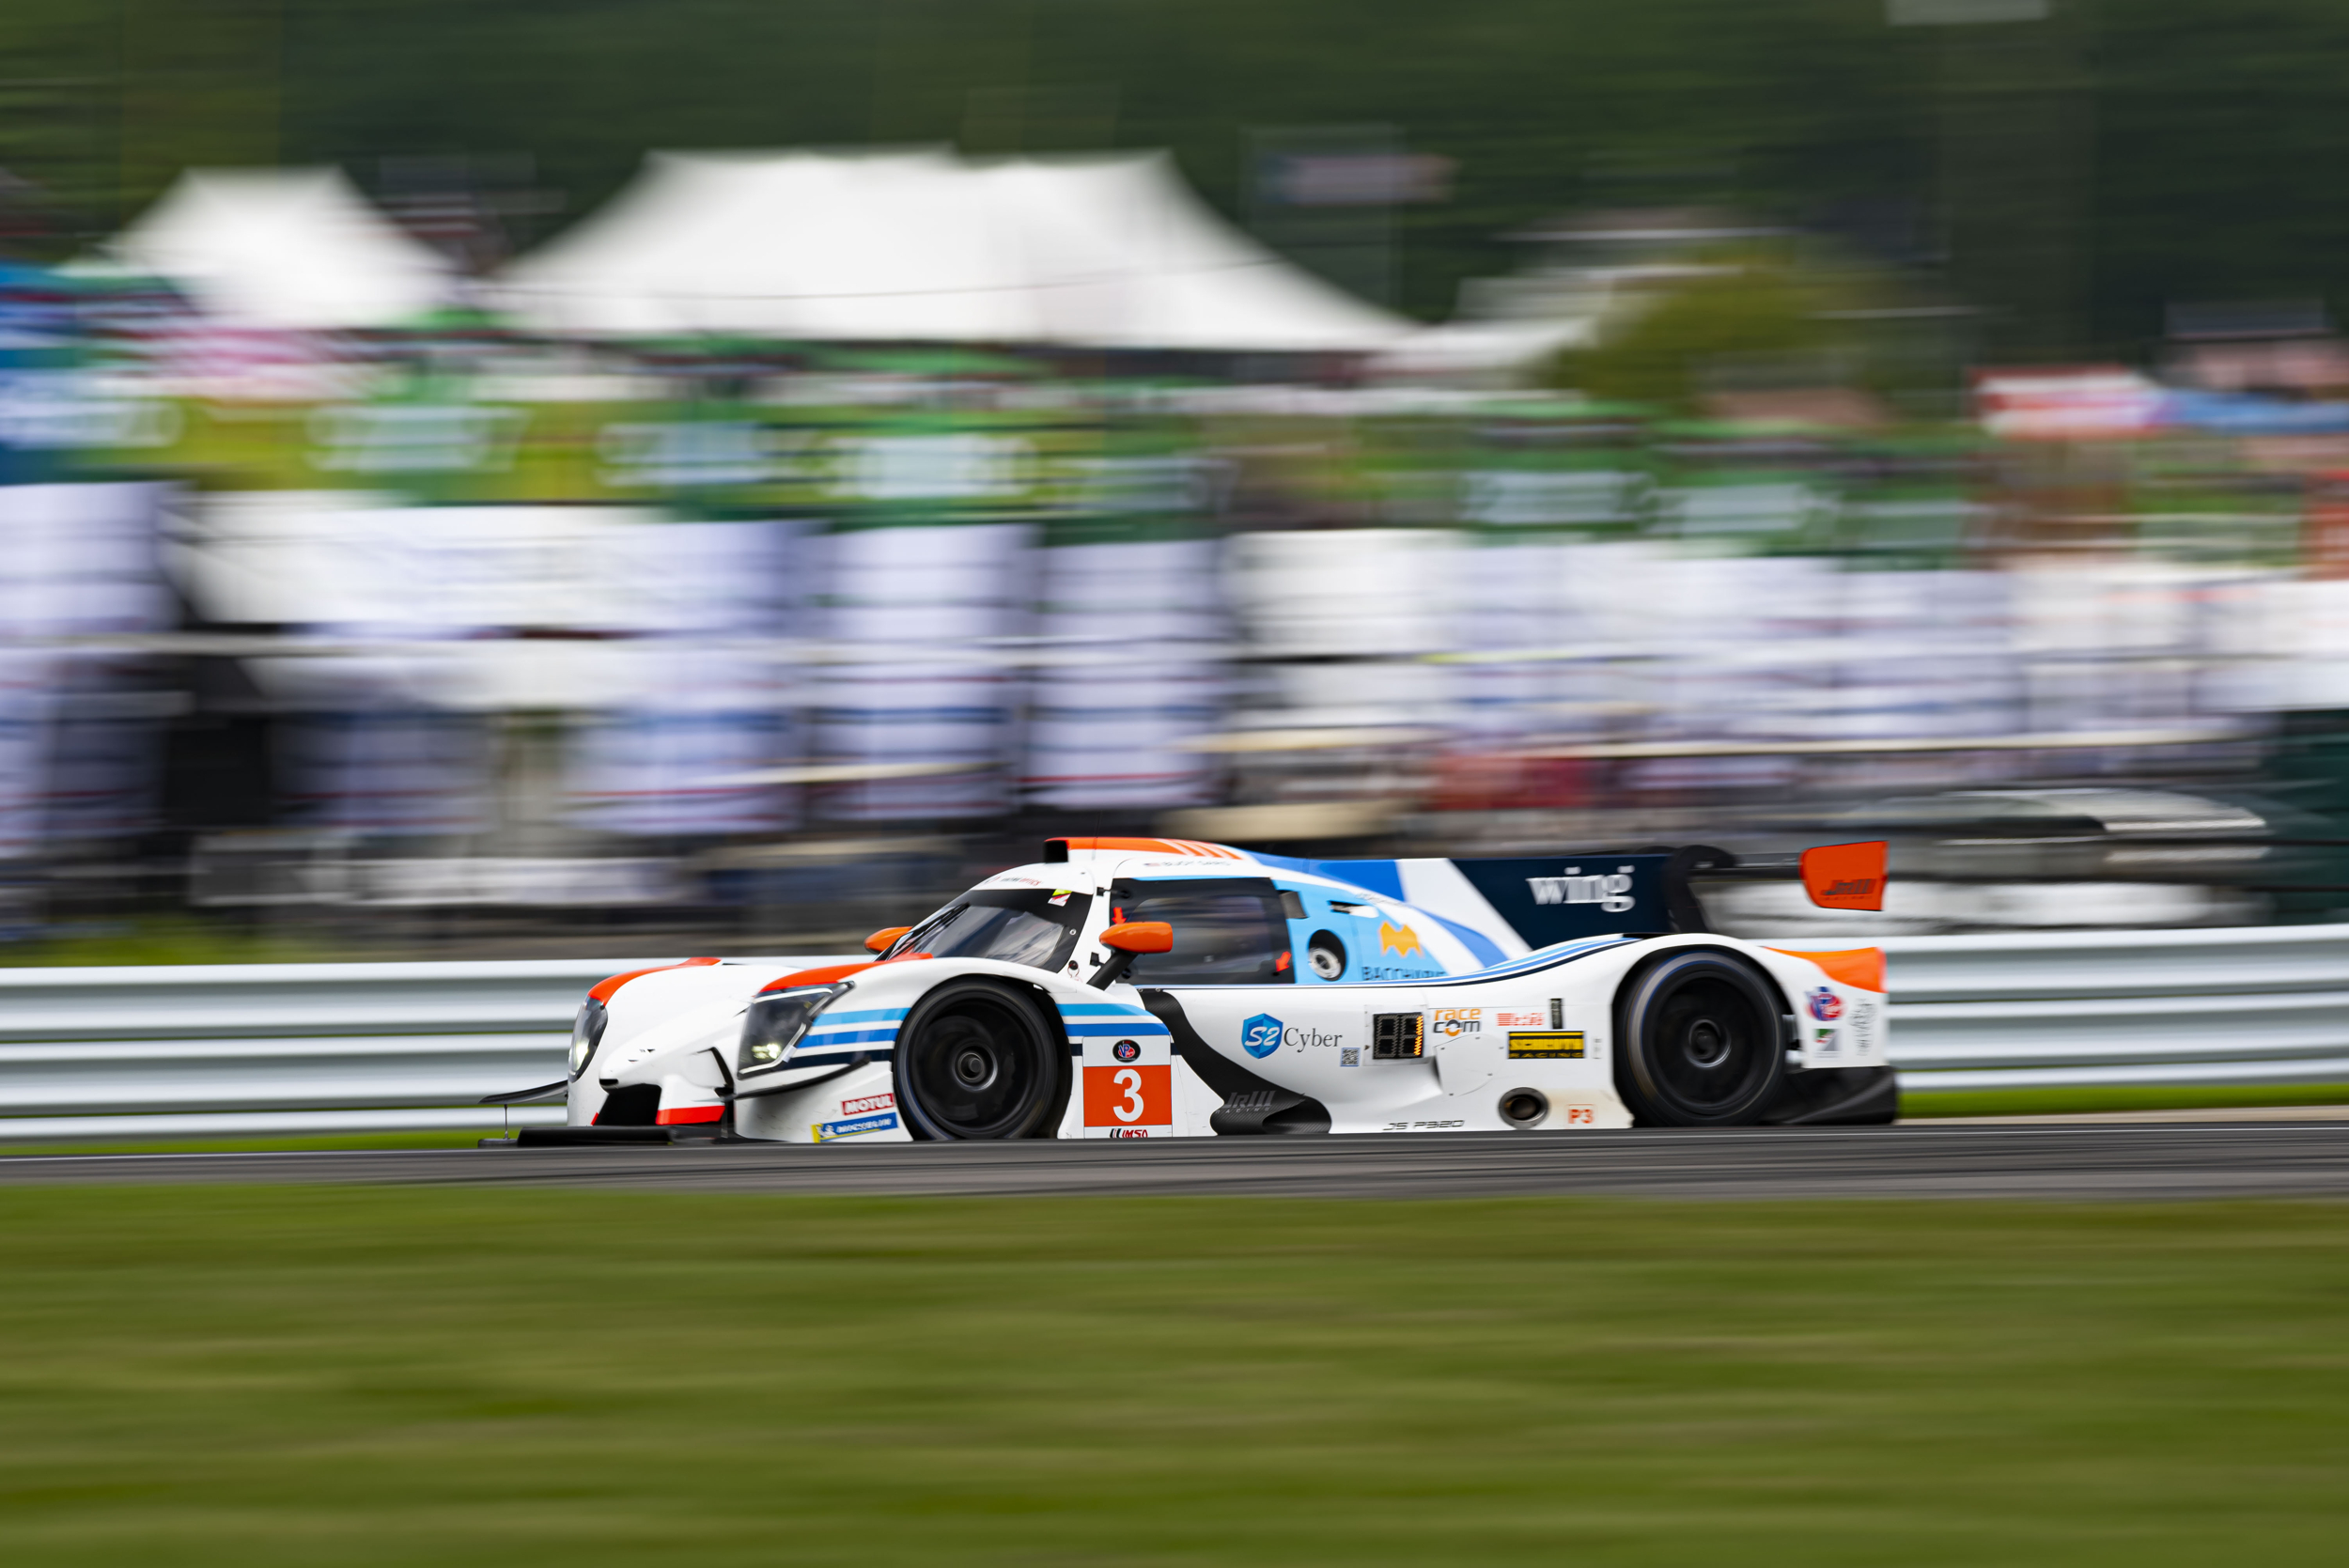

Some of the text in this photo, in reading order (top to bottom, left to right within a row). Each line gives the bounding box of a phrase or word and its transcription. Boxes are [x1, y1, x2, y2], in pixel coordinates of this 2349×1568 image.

[1525, 865, 1636, 912] wing
[1434, 1008, 1482, 1021] race
[1433, 1019, 1481, 1036] com
[1244, 1026, 1344, 1053] S2 Cyber
[847, 1094, 892, 1113] MOTUL
[1112, 1068, 1144, 1123] 3
[1567, 1109, 1595, 1125] P3
[1122, 1129, 1148, 1138] IMSA
